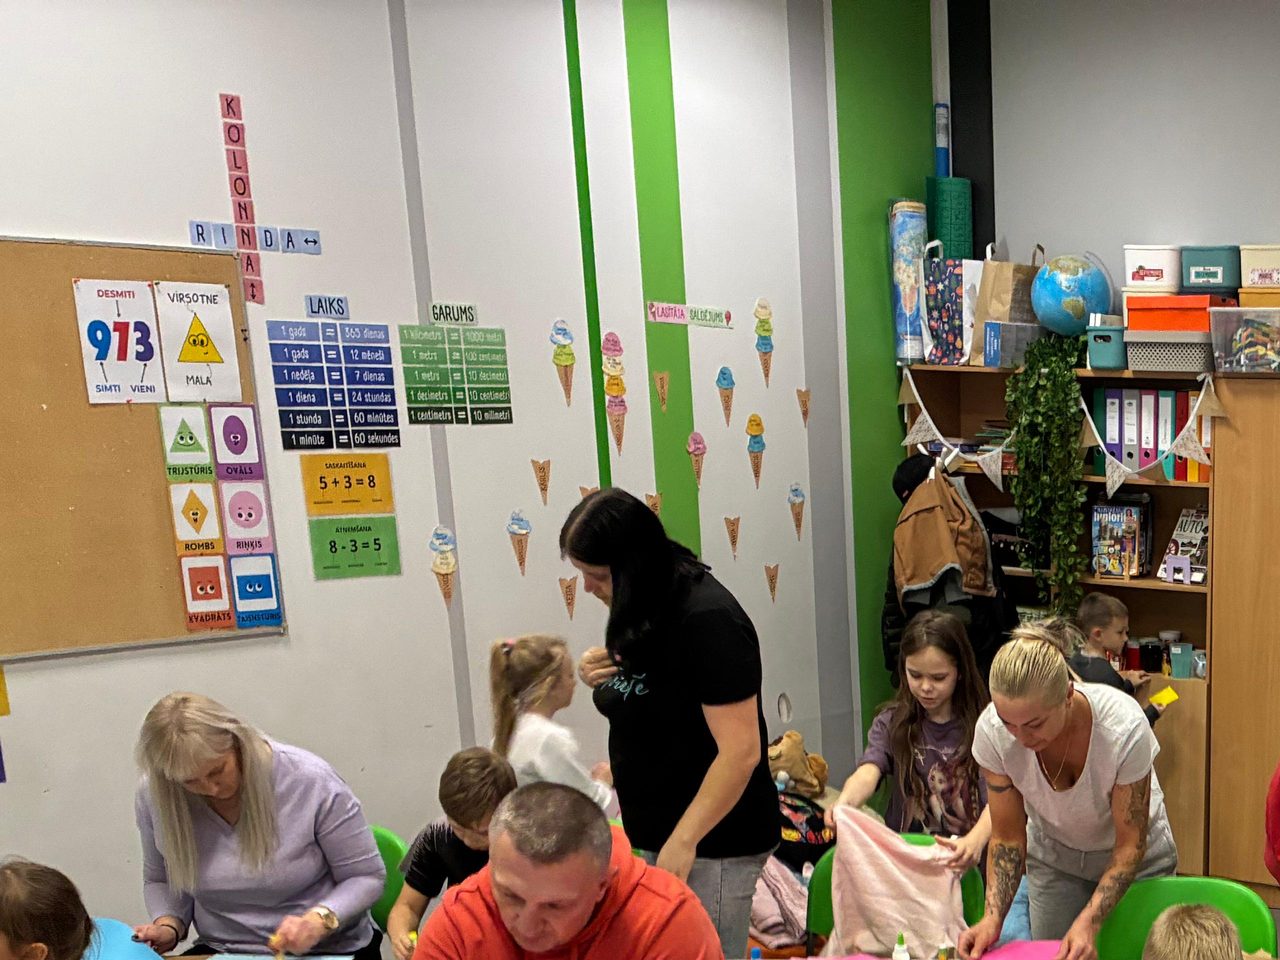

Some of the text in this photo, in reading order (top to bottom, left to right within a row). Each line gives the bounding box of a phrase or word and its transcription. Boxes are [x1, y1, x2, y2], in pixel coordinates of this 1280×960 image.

[225, 98, 255, 273] KOLONNA
[196, 224, 295, 250] RINDA
[97, 289, 135, 299] DESMITI
[168, 291, 218, 304] VIRSOTNE
[309, 297, 345, 316] LAIKS
[432, 305, 475, 322] GARUMS
[289, 327, 306, 339] gads
[363, 328, 385, 339] dienas
[87, 319, 154, 362] 973
[292, 349, 309, 362] gads
[350, 349, 359, 360] 12
[186, 375, 212, 386] MALA
[355, 371, 360, 380] 7
[363, 371, 385, 382] dienas
[96, 385, 120, 393] SIMTI
[130, 385, 155, 393] VIENI
[296, 391, 316, 402] diena
[352, 392, 362, 402] 24
[364, 392, 392, 402] stundas
[296, 413, 322, 424] stunda
[354, 413, 364, 423] 60
[473, 411, 482, 420] 10
[354, 434, 365, 444] 60
[367, 433, 398, 444] sekundes
[320, 476, 328, 490] 5
[344, 475, 352, 489] 3
[367, 475, 376, 488] 8
[1177, 519, 1204, 534] AUTO
[184, 542, 215, 551] ROMBS
[329, 540, 337, 554] 8
[350, 539, 358, 553] 3
[373, 537, 381, 551] 5
